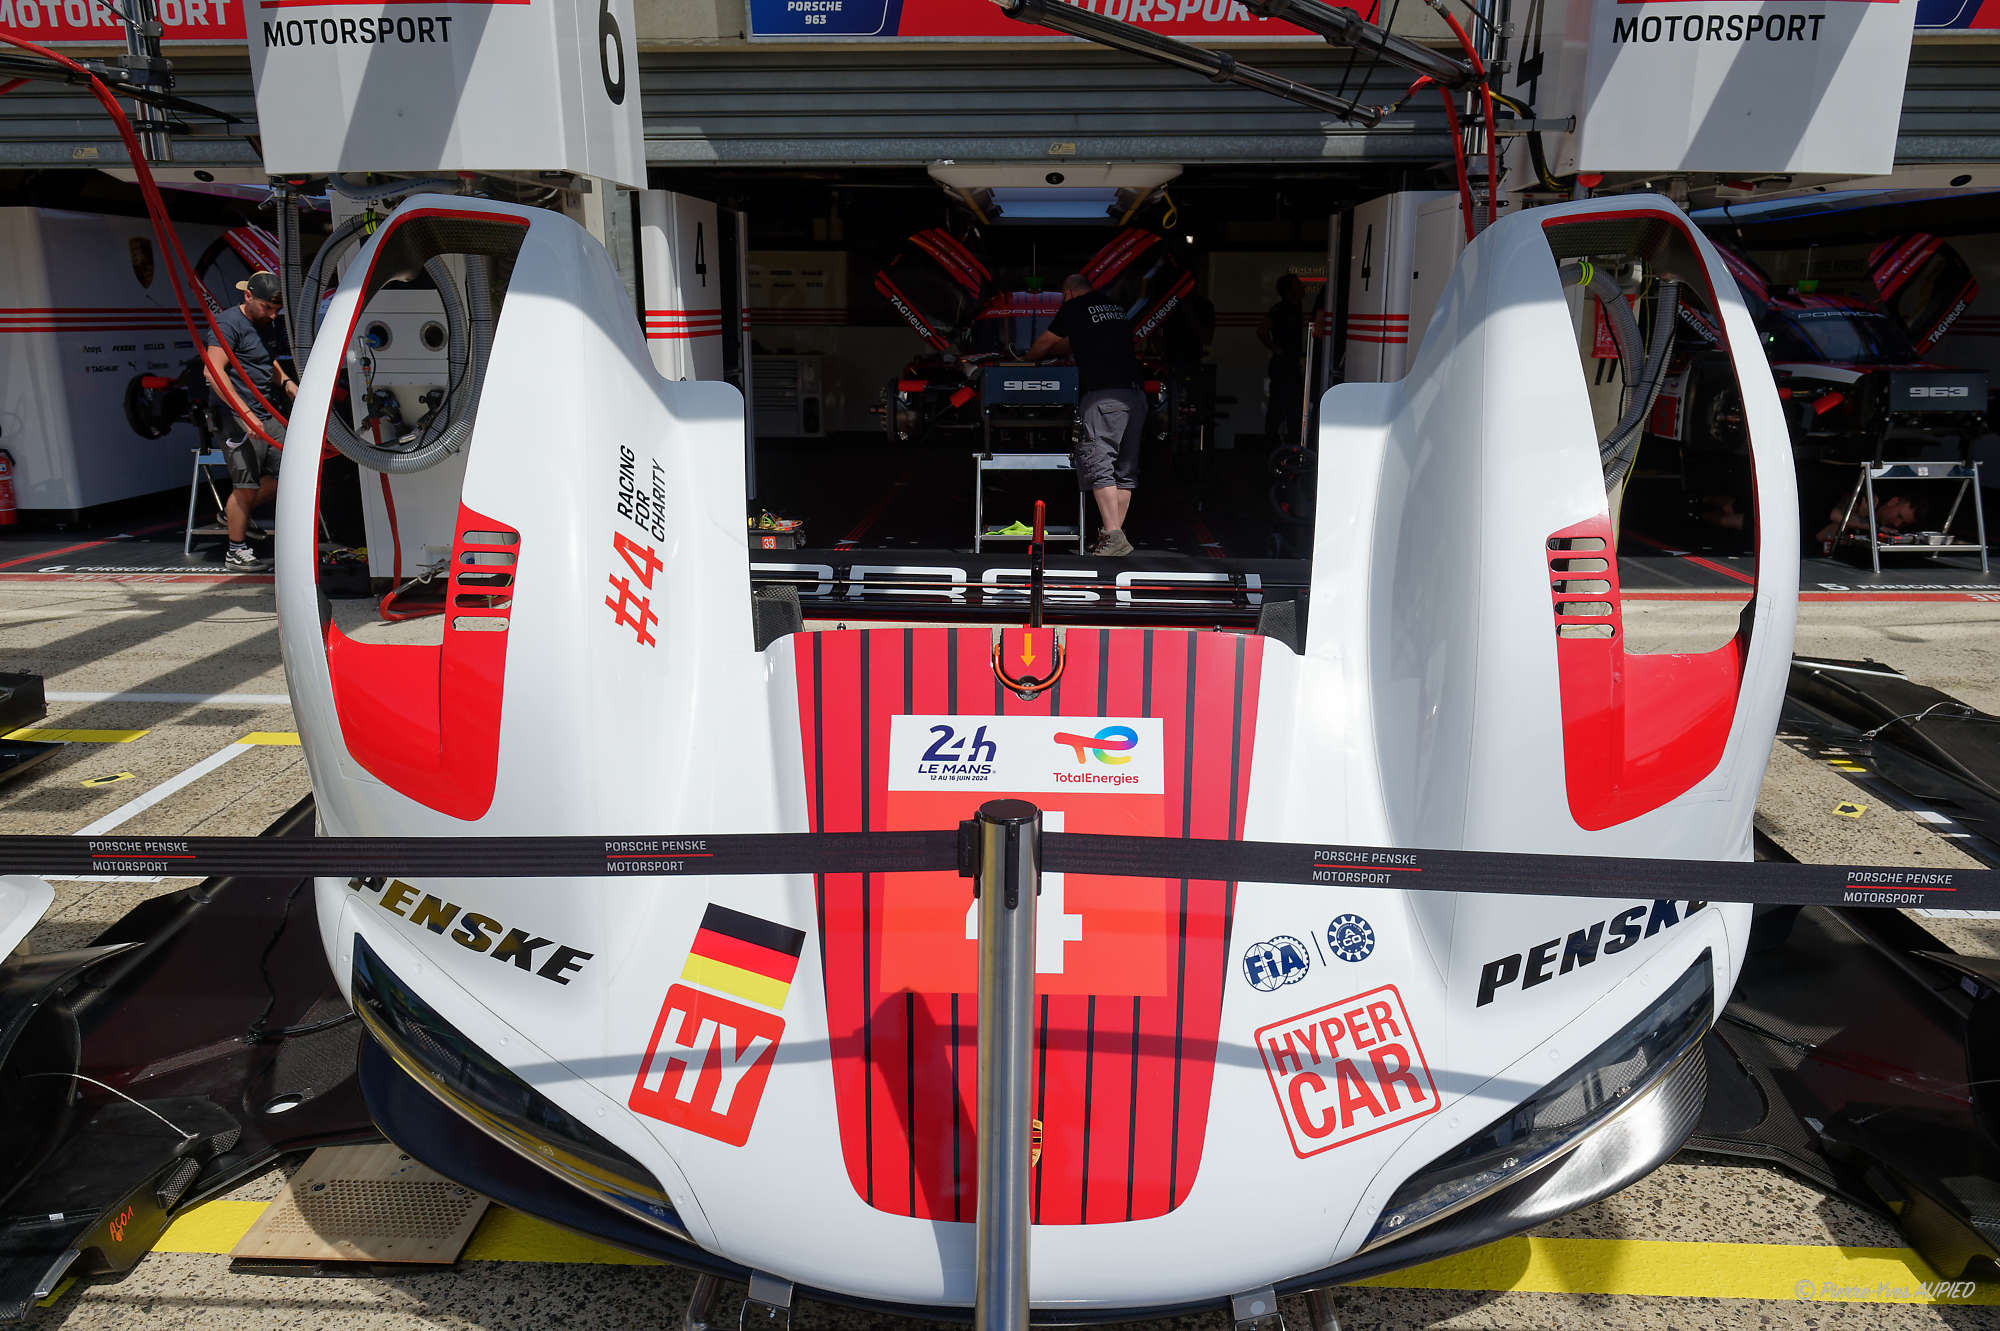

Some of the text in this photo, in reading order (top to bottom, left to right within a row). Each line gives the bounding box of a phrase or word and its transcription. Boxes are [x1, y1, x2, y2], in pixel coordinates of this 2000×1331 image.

[787, 1, 842, 11] PORSCHE
[0, 0, 230, 28] MOTORORT
[805, 14, 827, 24] 963
[263, 16, 452, 47] MOTORSPORT
[1612, 14, 1826, 43] MOTORSPORT
[598, 0, 626, 106] 6
[695, 221, 707, 288] 4
[1360, 223, 1372, 291] 4
[1003, 380, 1060, 391] 963
[1909, 386, 1969, 397] 963
[617, 444, 635, 520] RACING
[651, 457, 665, 542] CHARITY
[635, 489, 651, 532] FOR
[763, 538, 775, 549] 33
[604, 530, 664, 649] #4
[921, 725, 997, 762] 24h
[918, 764, 992, 774] LE MANS
[1053, 772, 1139, 786] TotalEnergies
[88, 841, 189, 852] PORSCHE PENSKE
[605, 840, 707, 852] PORSCHE PENSKE
[1314, 850, 1417, 865] PORSCHE PENSKE
[92, 861, 169, 872] MOTORSPORT
[607, 861, 685, 872] MOTORSPORT
[1312, 870, 1392, 884] MOTORSPORT
[1847, 871, 1953, 885] PORSCHE PENSKE
[1843, 891, 1925, 904] MOTORSPORT
[1267, 1000, 1403, 1077] HYPER
[642, 1007, 774, 1116] HY
[1288, 1043, 1428, 1139] CAR
